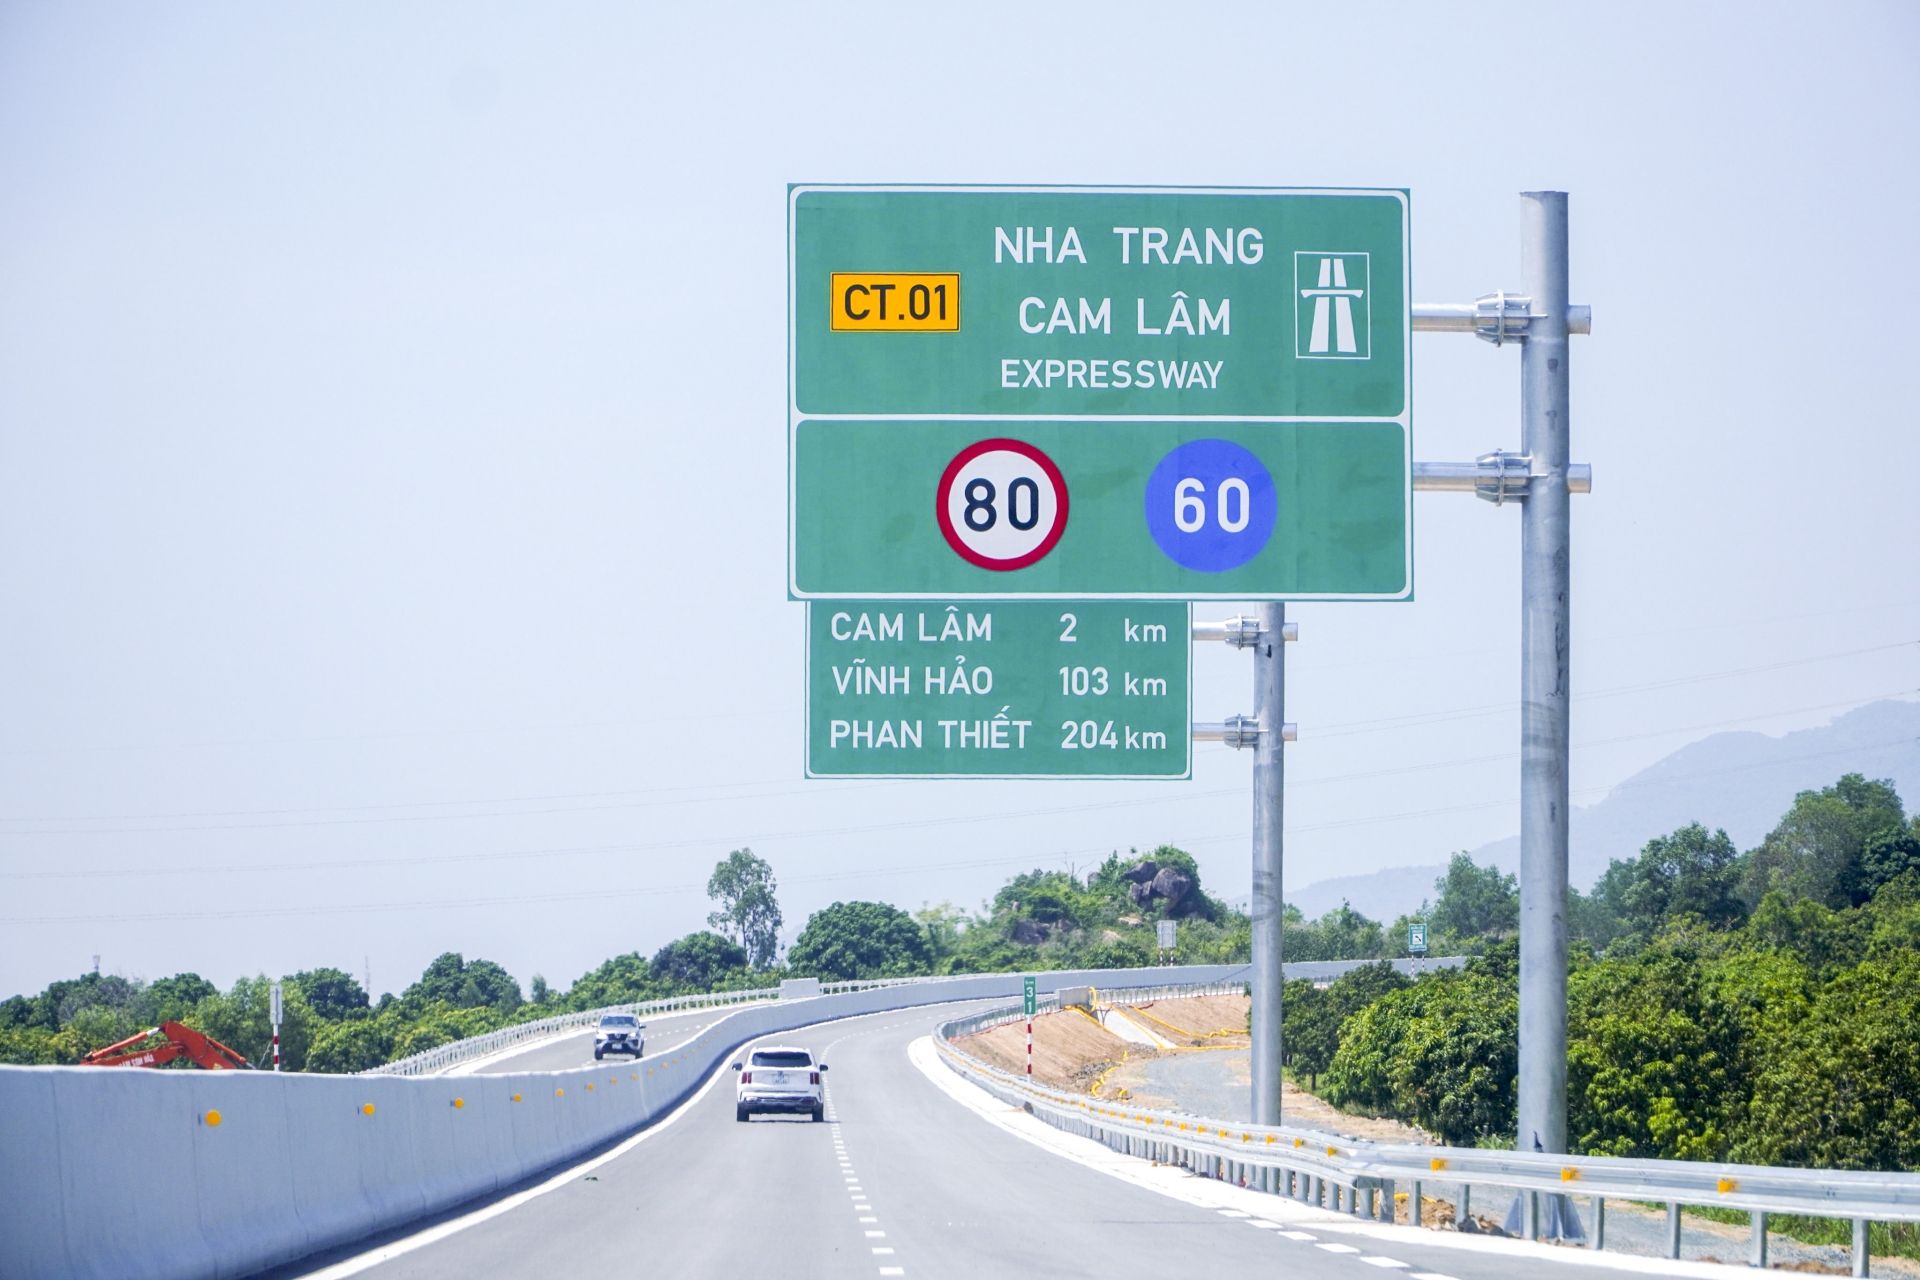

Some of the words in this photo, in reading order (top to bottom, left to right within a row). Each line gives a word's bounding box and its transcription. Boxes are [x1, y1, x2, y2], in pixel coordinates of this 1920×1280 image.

[995, 226, 1087, 264] NHA
[1113, 227, 1264, 265] TRANG
[844, 284, 946, 321] CT.01
[1019, 297, 1111, 335] CAM
[1137, 291, 1230, 336] LÂM
[1001, 359, 1224, 389] EXPRESSWAY
[963, 477, 1040, 533] 80
[1174, 477, 1250, 533] 60
[831, 612, 904, 641] CAM
[918, 606, 992, 641] LÂM
[1060, 613, 1077, 642] 2
[1124, 618, 1167, 642] km
[831, 658, 910, 695] VĨNH
[924, 655, 993, 695] HẢO
[1059, 667, 1109, 696] 103
[1124, 671, 1167, 696] km
[830, 720, 923, 749] PHAN
[938, 706, 1032, 749] THIẾT
[1061, 720, 1118, 749] 204
[1124, 725, 1166, 749] km
